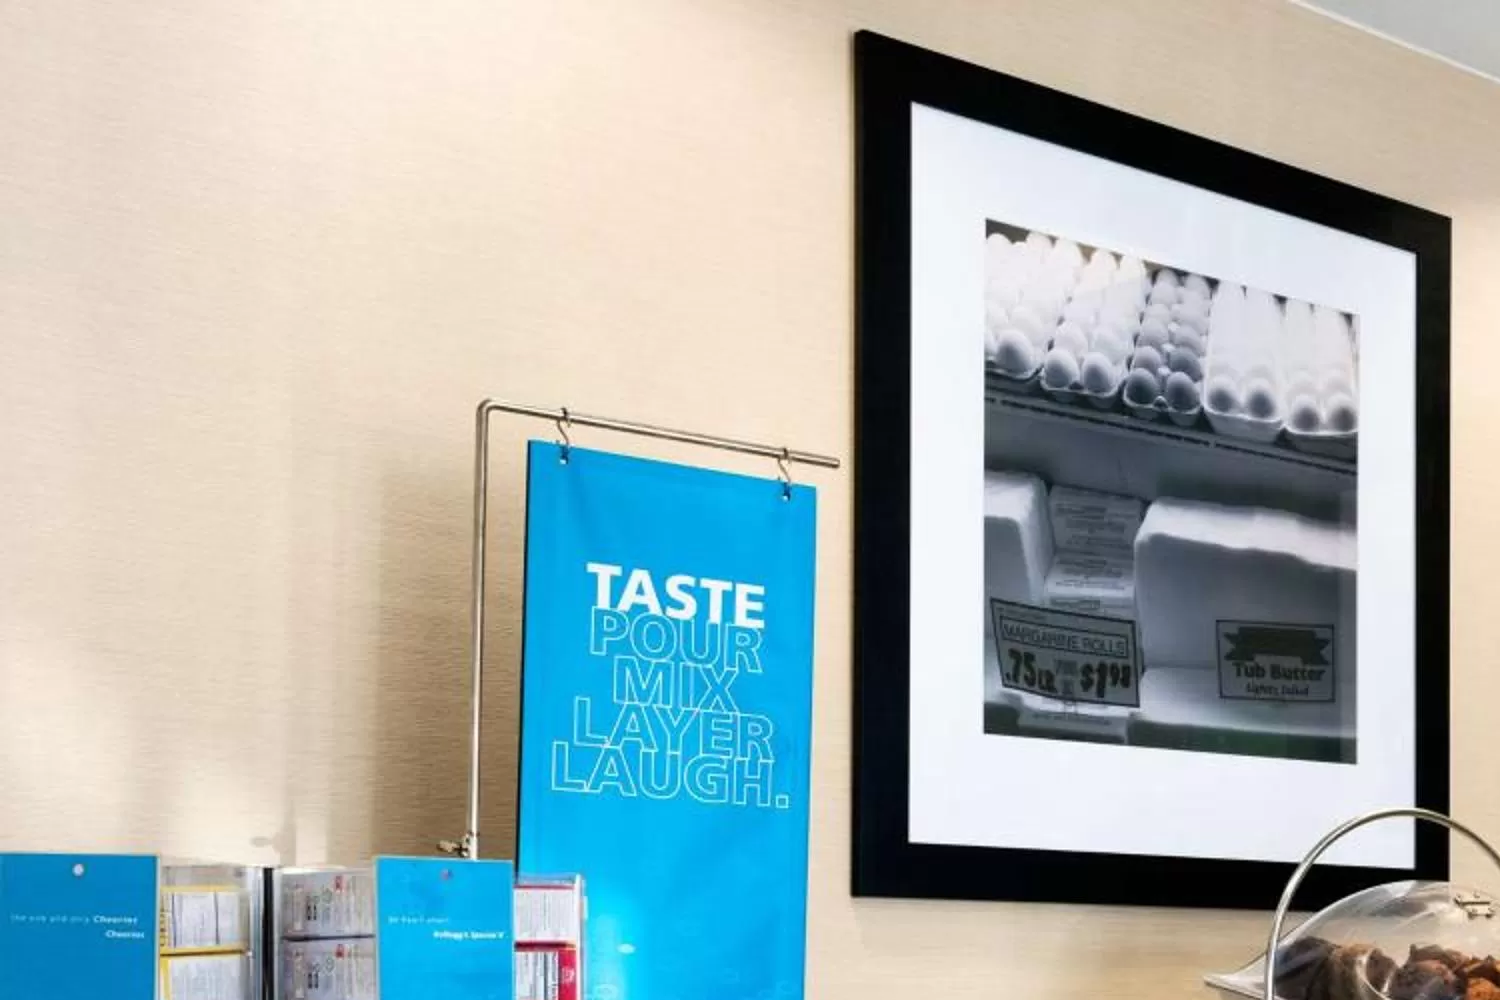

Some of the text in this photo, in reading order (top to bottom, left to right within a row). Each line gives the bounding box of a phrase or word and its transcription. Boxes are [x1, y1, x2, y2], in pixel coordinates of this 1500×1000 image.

[586, 562, 765, 629] TASTE
[590, 606, 763, 673] POUR
[1231, 661, 1326, 681] Tub Butter
[613, 655, 741, 716] MIX
[573, 695, 775, 763] LAYER
[551, 740, 789, 809] LAUGH.
